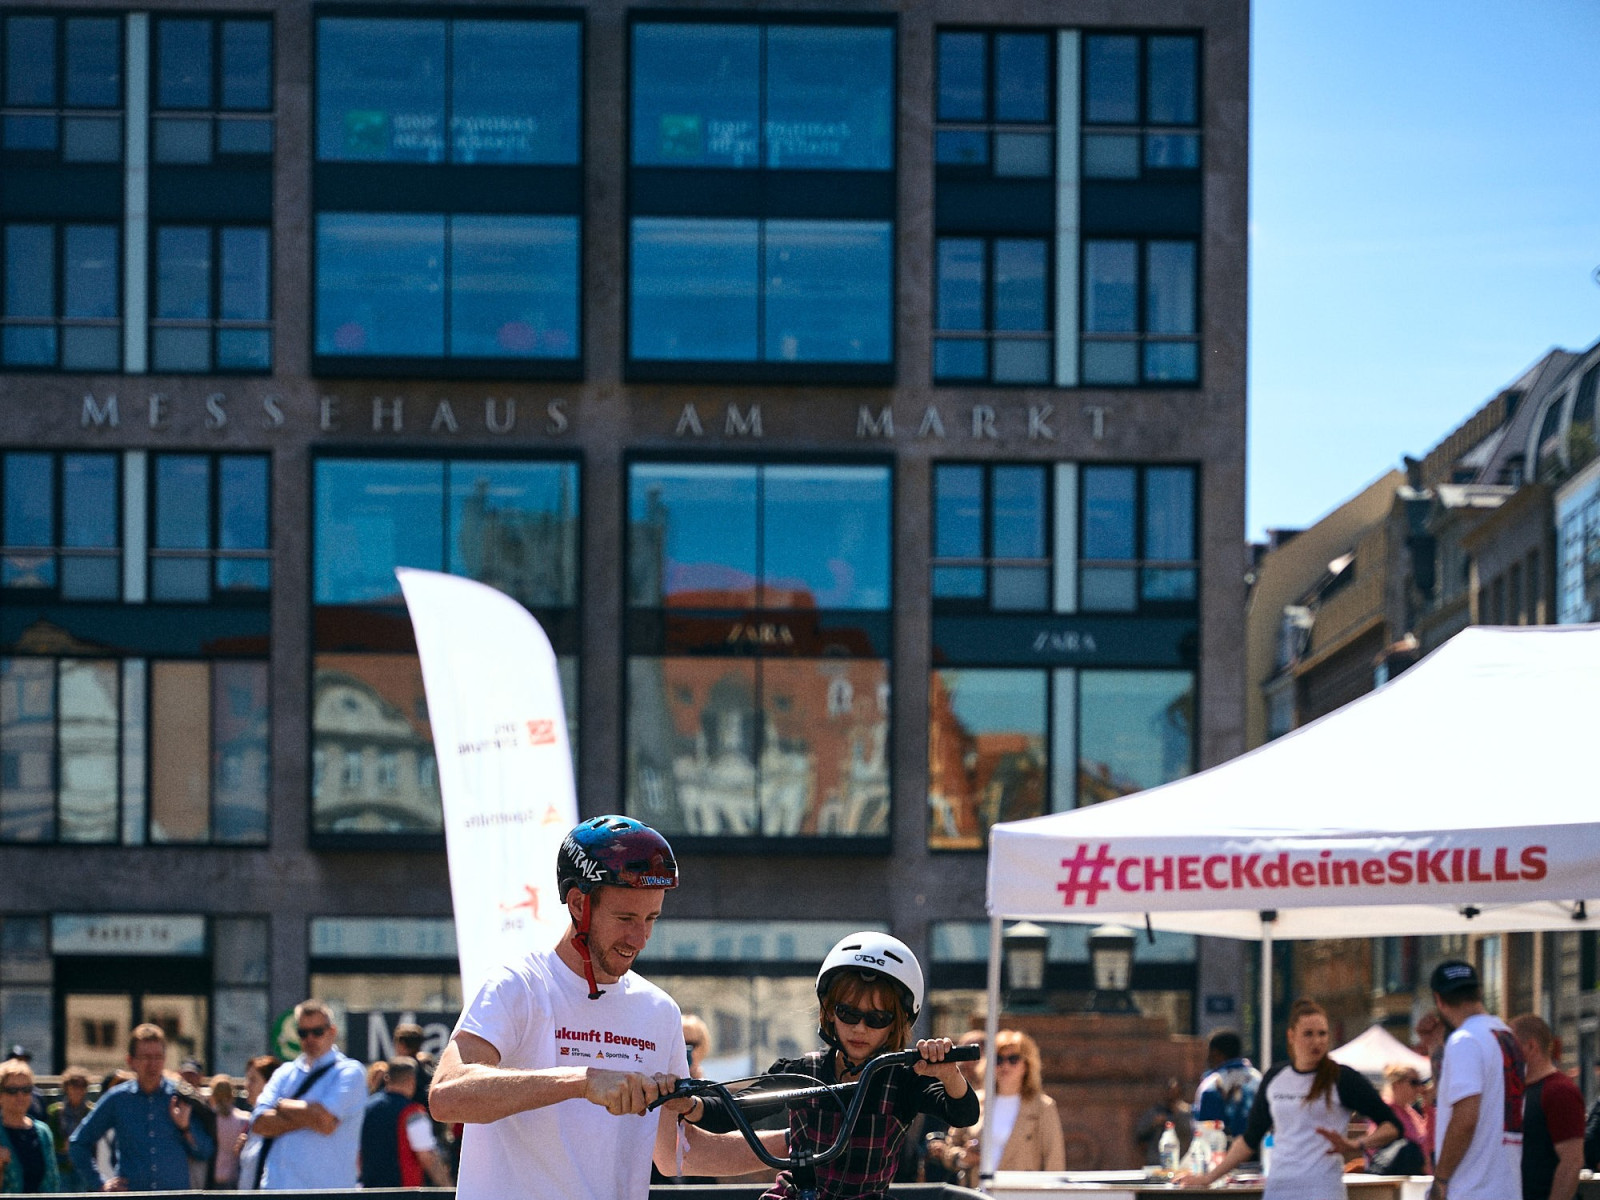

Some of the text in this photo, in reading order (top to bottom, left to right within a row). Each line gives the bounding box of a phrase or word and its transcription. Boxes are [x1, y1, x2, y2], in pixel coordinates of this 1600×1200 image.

[80, 393, 1114, 439] MESSEHAUS AM MARKT
[1056, 843, 1549, 907] #CHECKdeineSKILLS
[555, 1027, 656, 1052] ukunft Bewegen
